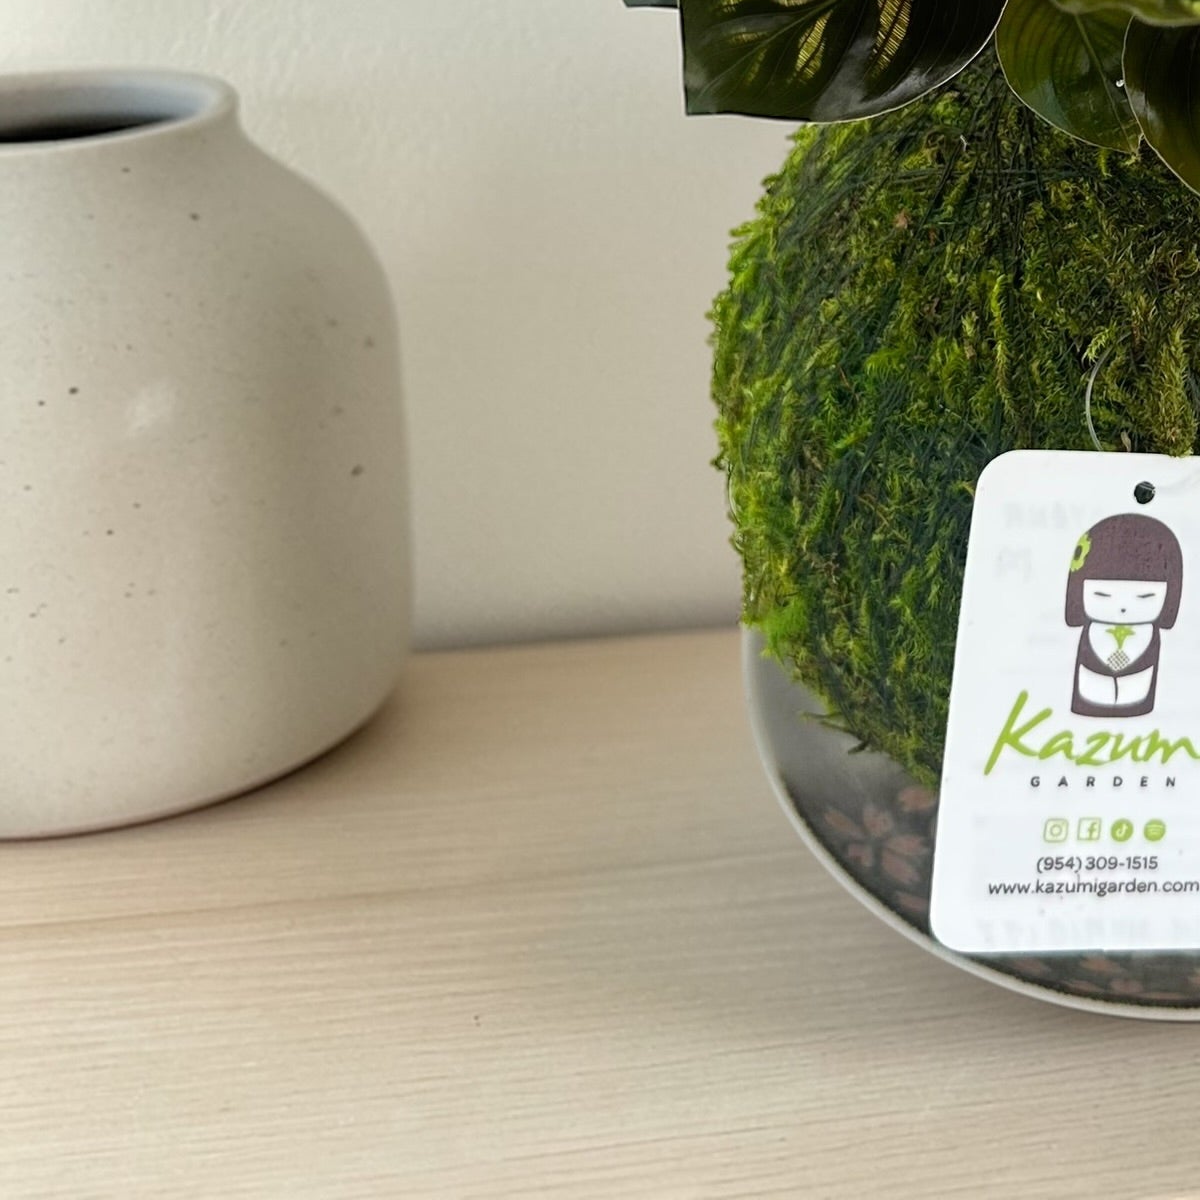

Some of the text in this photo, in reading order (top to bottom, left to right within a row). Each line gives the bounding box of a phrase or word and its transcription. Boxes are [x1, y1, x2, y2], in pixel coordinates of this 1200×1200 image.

[1030, 776, 1176, 788] GARDEN
[1036, 856, 1158, 873] (954) 309-1515
[988, 878, 1200, 896] www.kazumigarden.com
